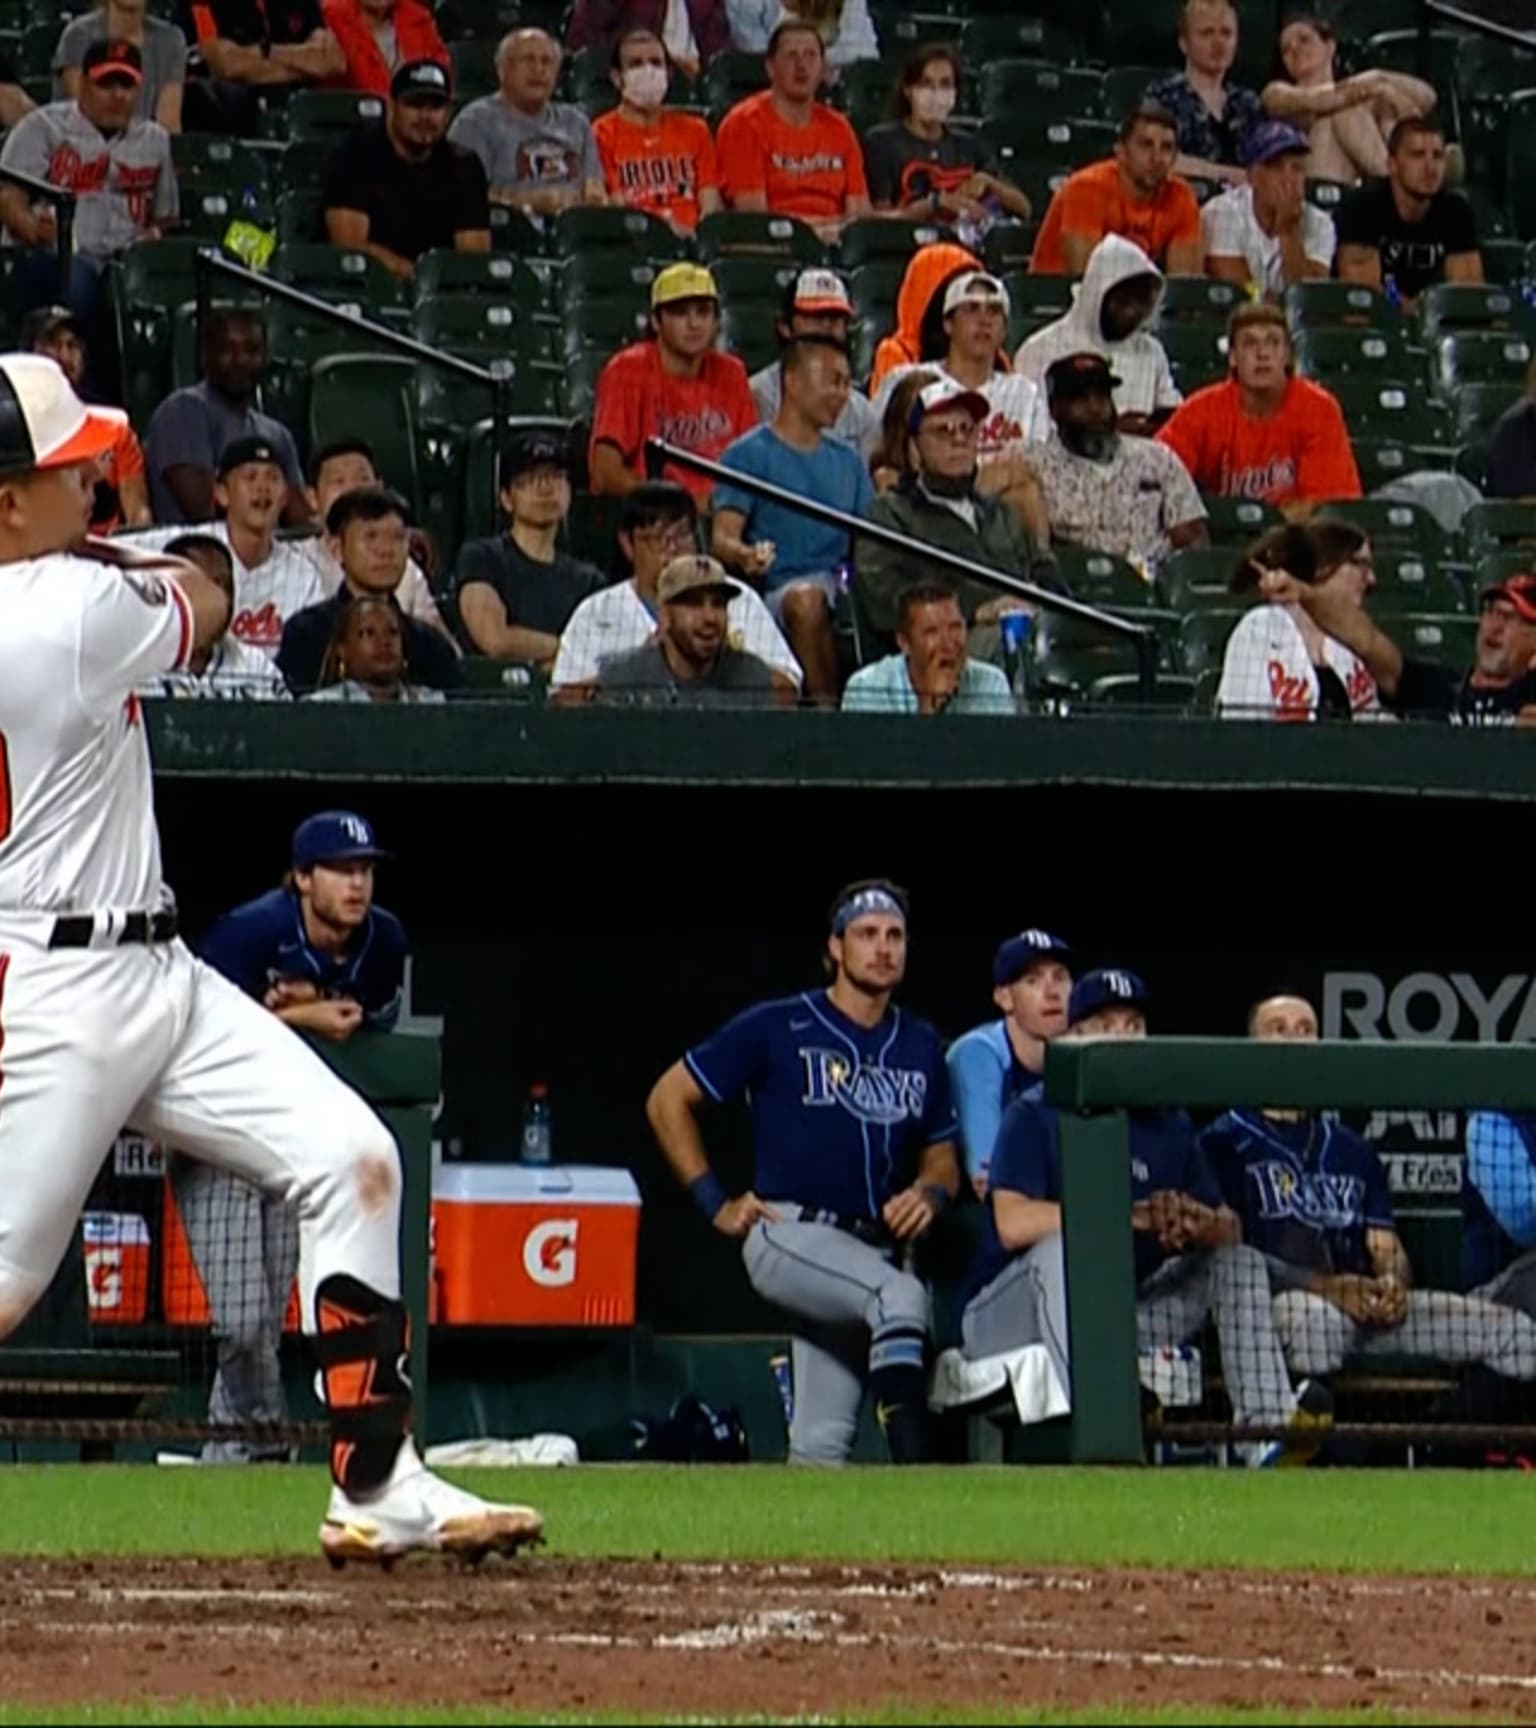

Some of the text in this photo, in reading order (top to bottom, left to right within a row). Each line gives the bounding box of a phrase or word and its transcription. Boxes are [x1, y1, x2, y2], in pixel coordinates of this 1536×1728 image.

[340, 816, 369, 844] TB
[1102, 969, 1133, 998] TB
[523, 1217, 579, 1289] G
